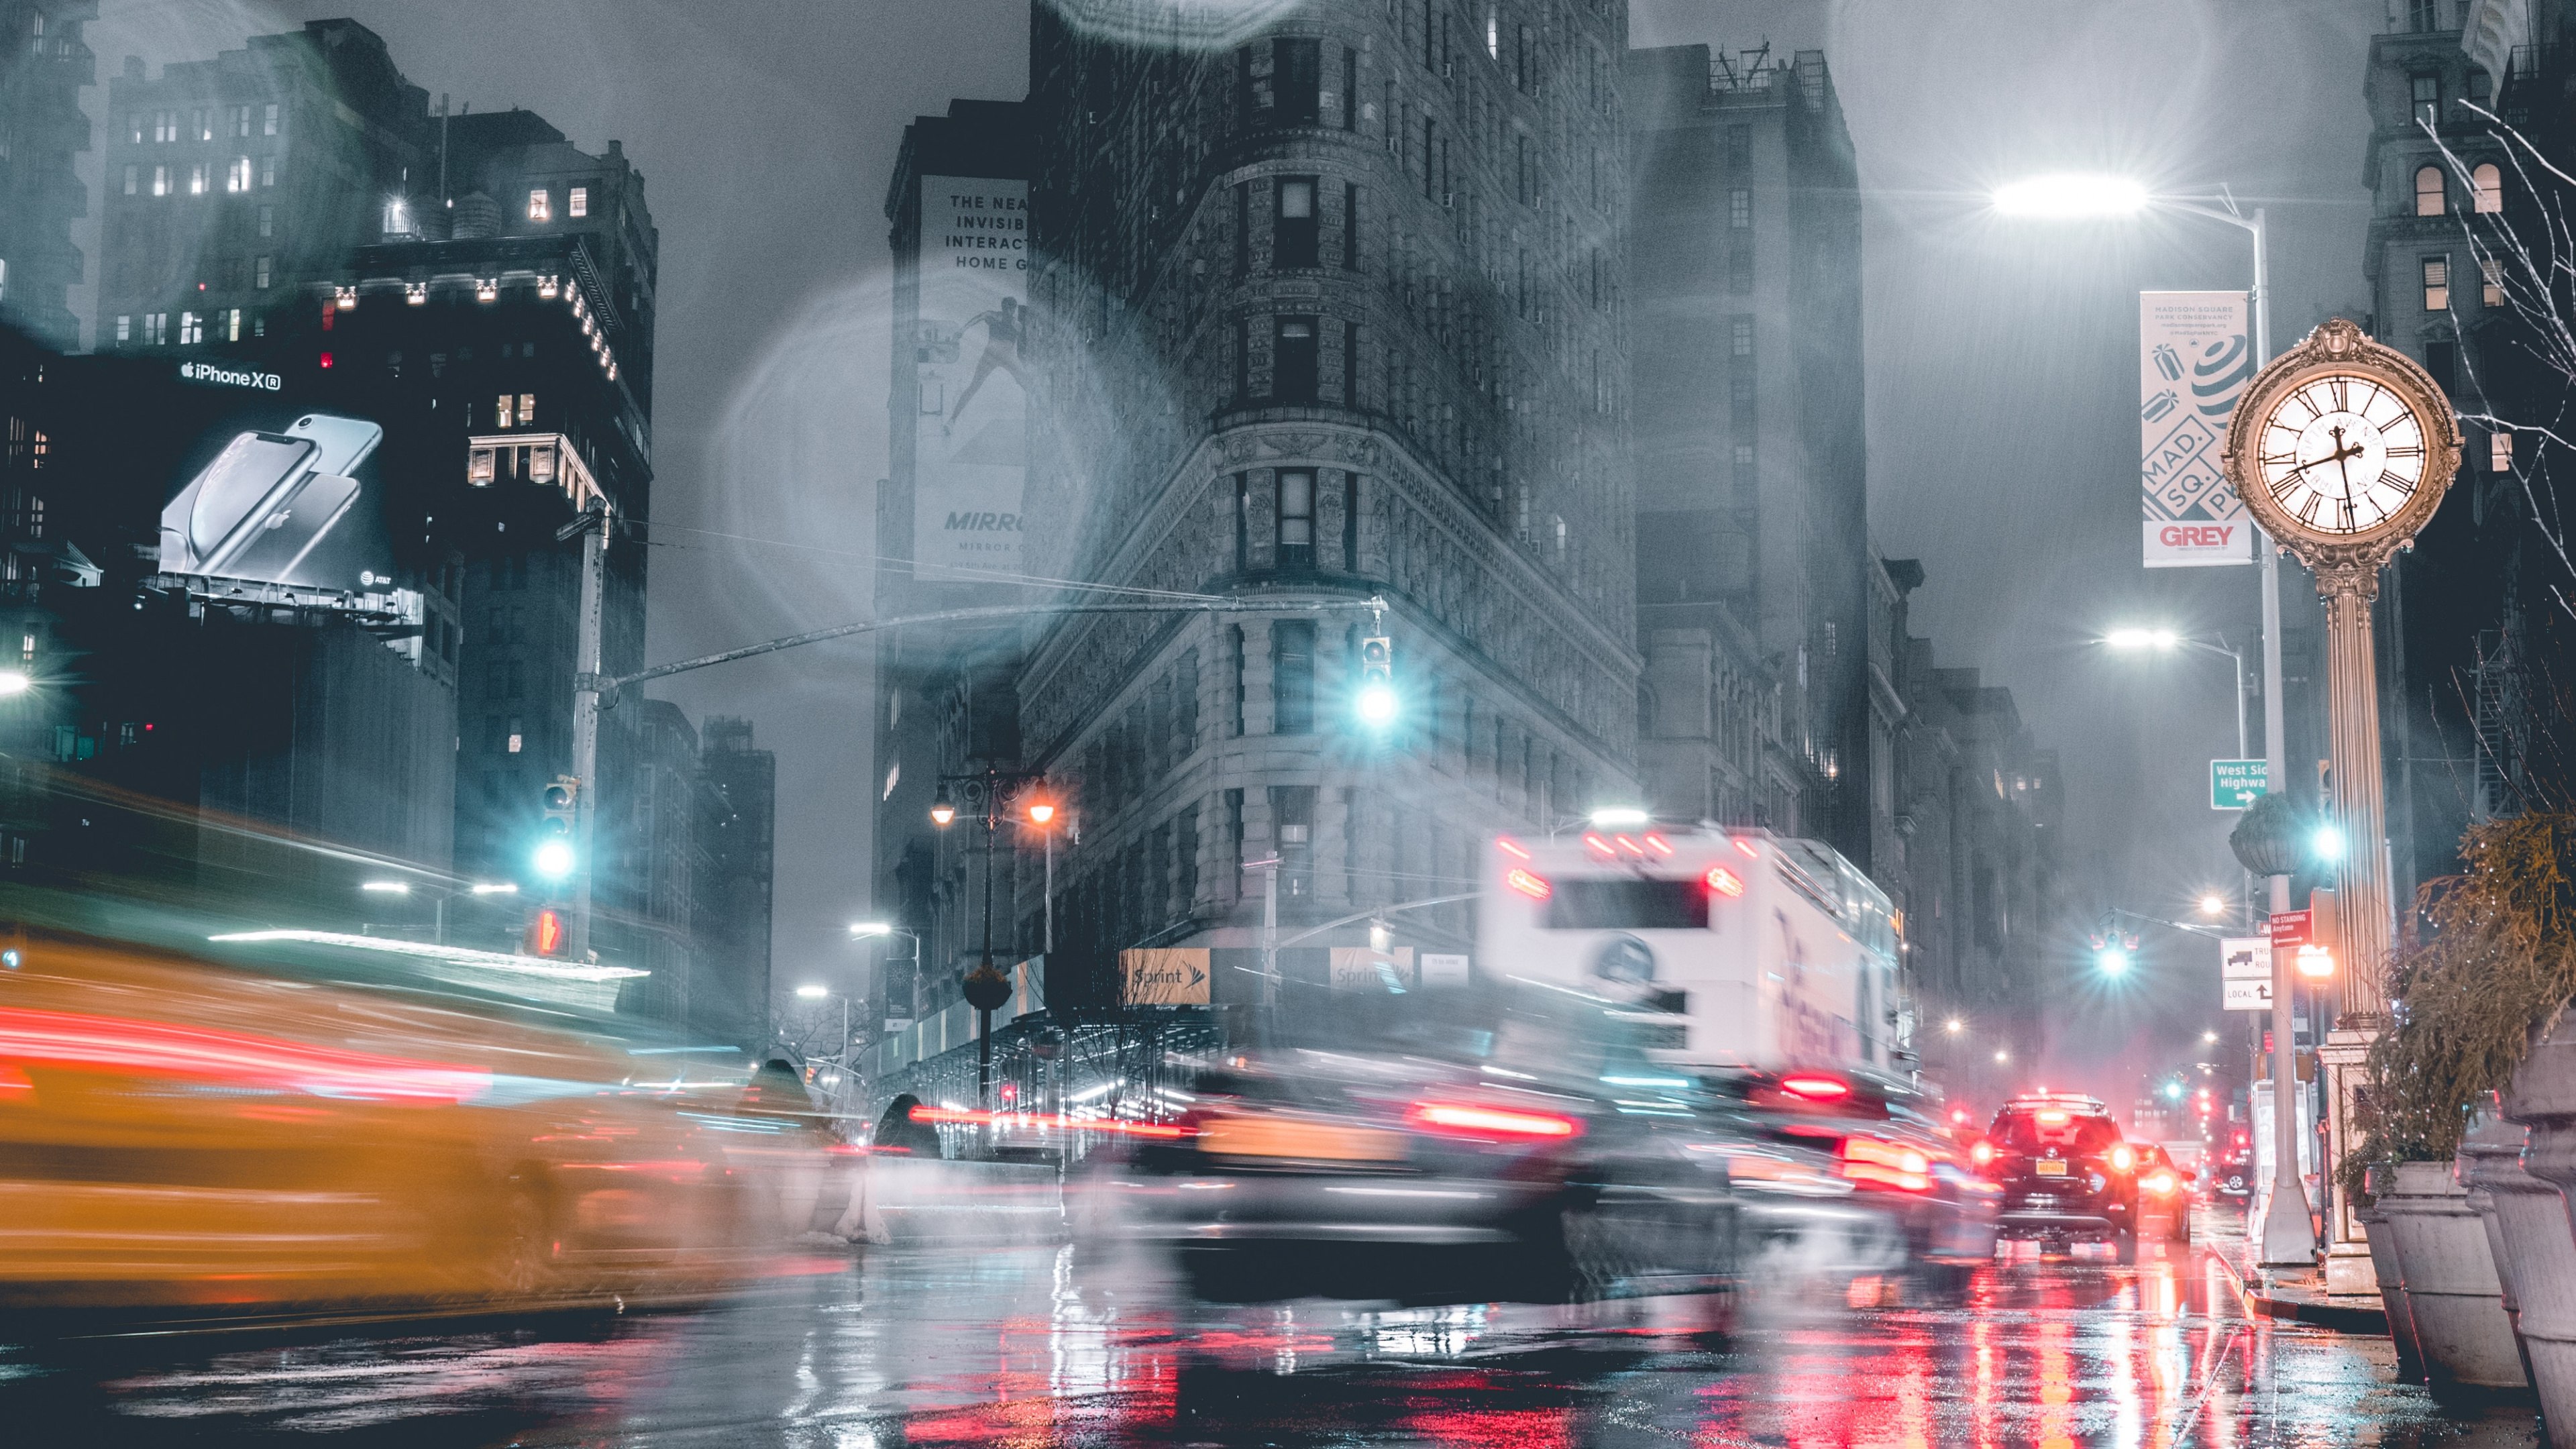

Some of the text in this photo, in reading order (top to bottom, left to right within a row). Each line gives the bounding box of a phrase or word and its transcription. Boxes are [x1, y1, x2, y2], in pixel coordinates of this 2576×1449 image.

[951, 195, 1027, 211] THE NEA
[957, 216, 1024, 230] INVISIB
[946, 235, 1027, 250] INTERAC
[957, 256, 1026, 270] HOME G
[195, 363, 250, 386] iPhone
[2142, 434, 2203, 485] MAD.
[2167, 474, 2210, 508] SQ.
[2159, 526, 2234, 547] GREY
[375, 576, 391, 584] AT&T
[2216, 765, 2246, 775] West
[2220, 777, 2265, 790] Highwa
[2280, 914, 2306, 924] STANDING
[2273, 924, 2294, 933] Anytime
[2255, 947, 2271, 955] TRU
[1134, 969, 1182, 987] Sprint
[2227, 990, 2252, 998] LOCAL
